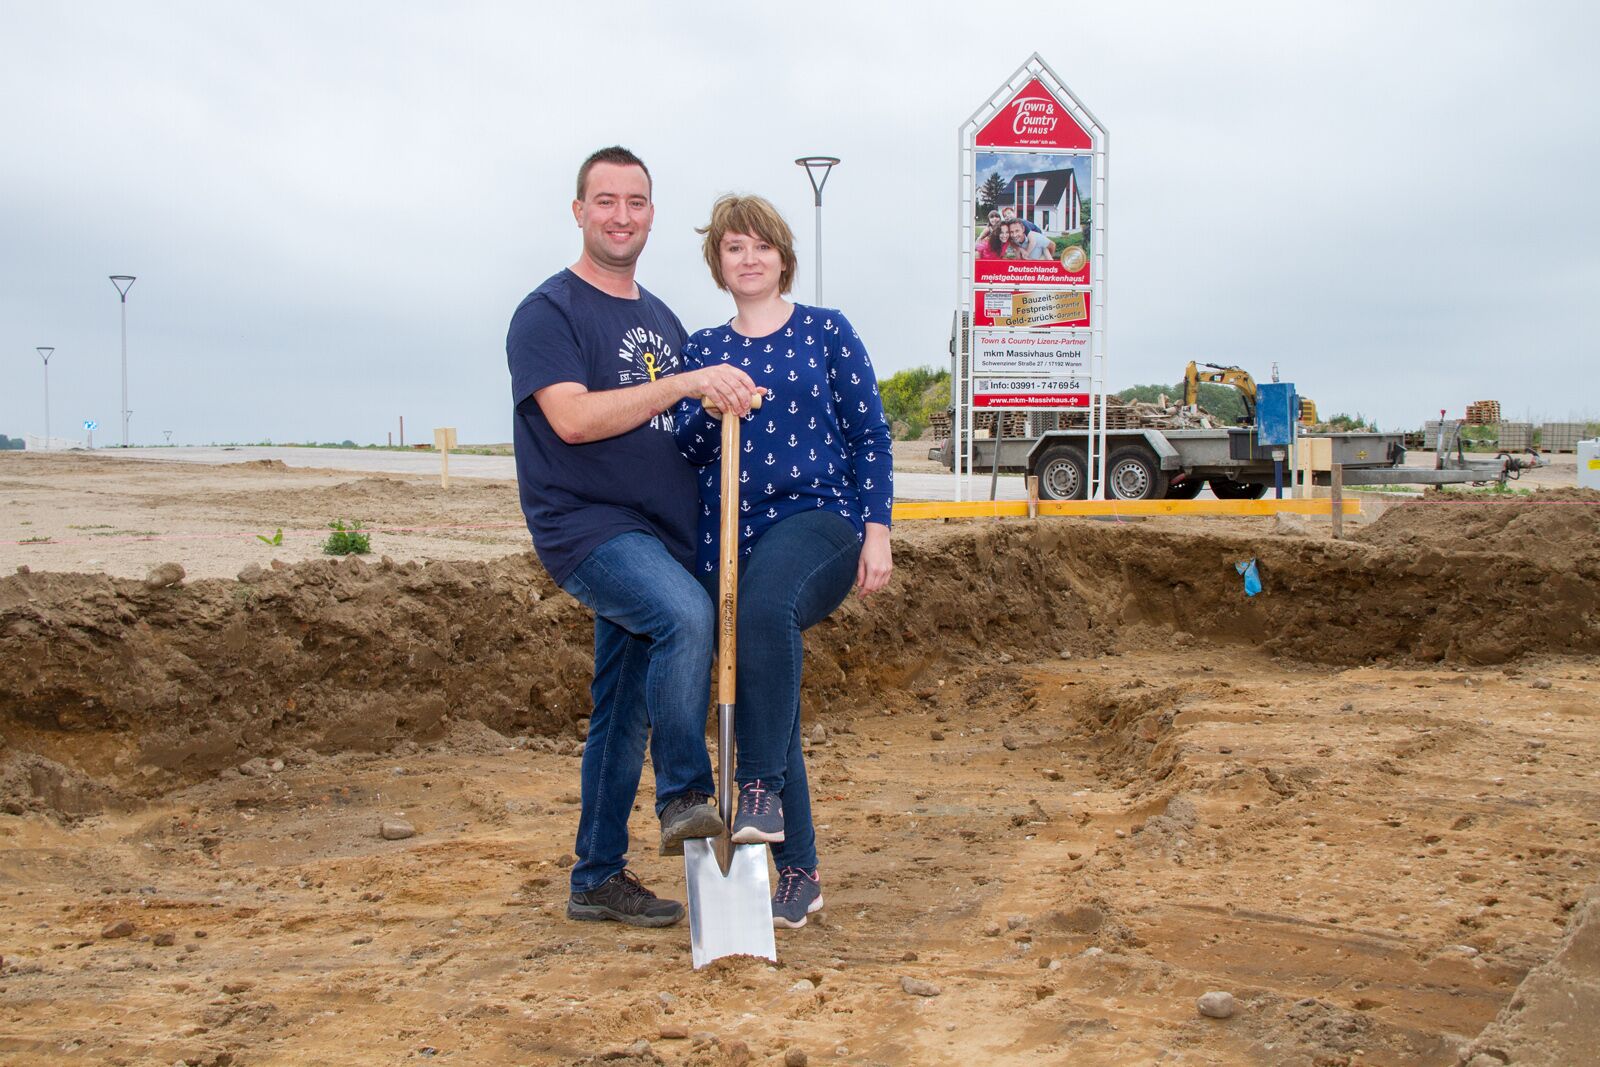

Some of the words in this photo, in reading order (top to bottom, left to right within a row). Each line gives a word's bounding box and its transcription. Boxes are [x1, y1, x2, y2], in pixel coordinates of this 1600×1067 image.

[1011, 97, 1052, 114] Town
[1045, 103, 1054, 114] &
[1013, 111, 1057, 134] Country
[1008, 265, 1058, 273] Deutschlands
[981, 274, 1035, 282] meistgebautes
[1037, 274, 1085, 282] Markenhaus!
[618, 327, 679, 368] NAVIGATOR
[1056, 350, 1081, 358] GmbH
[620, 373, 632, 382] EST.
[990, 381, 1009, 389] Info:
